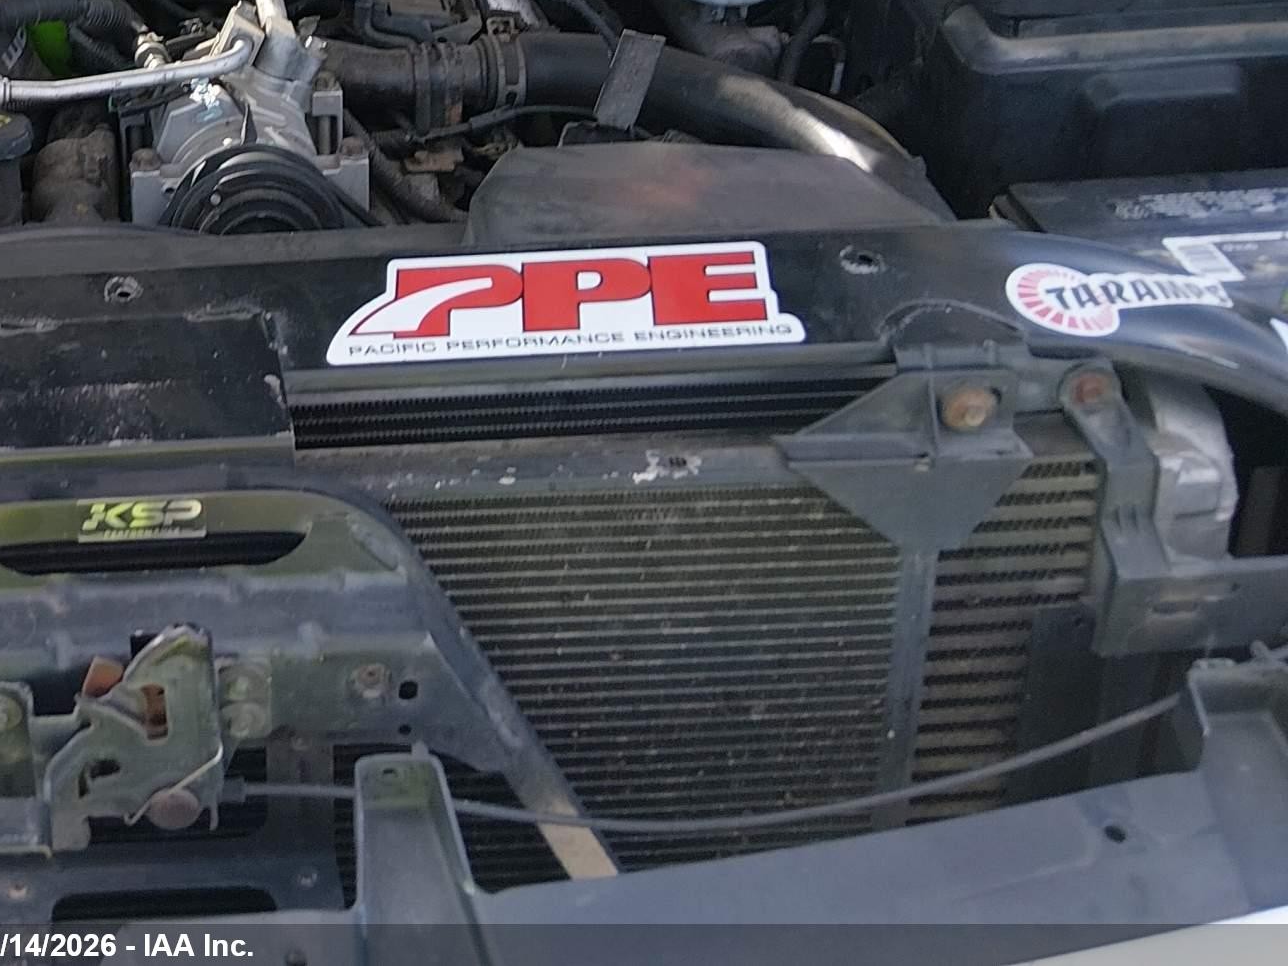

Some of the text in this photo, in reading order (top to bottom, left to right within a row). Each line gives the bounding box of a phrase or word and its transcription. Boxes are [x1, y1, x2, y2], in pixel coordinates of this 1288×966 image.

[349, 250, 768, 339] PPE
[349, 323, 792, 356] PACIFIC PERFORMANCE ENGINEERING
[81, 498, 203, 531] KSP
